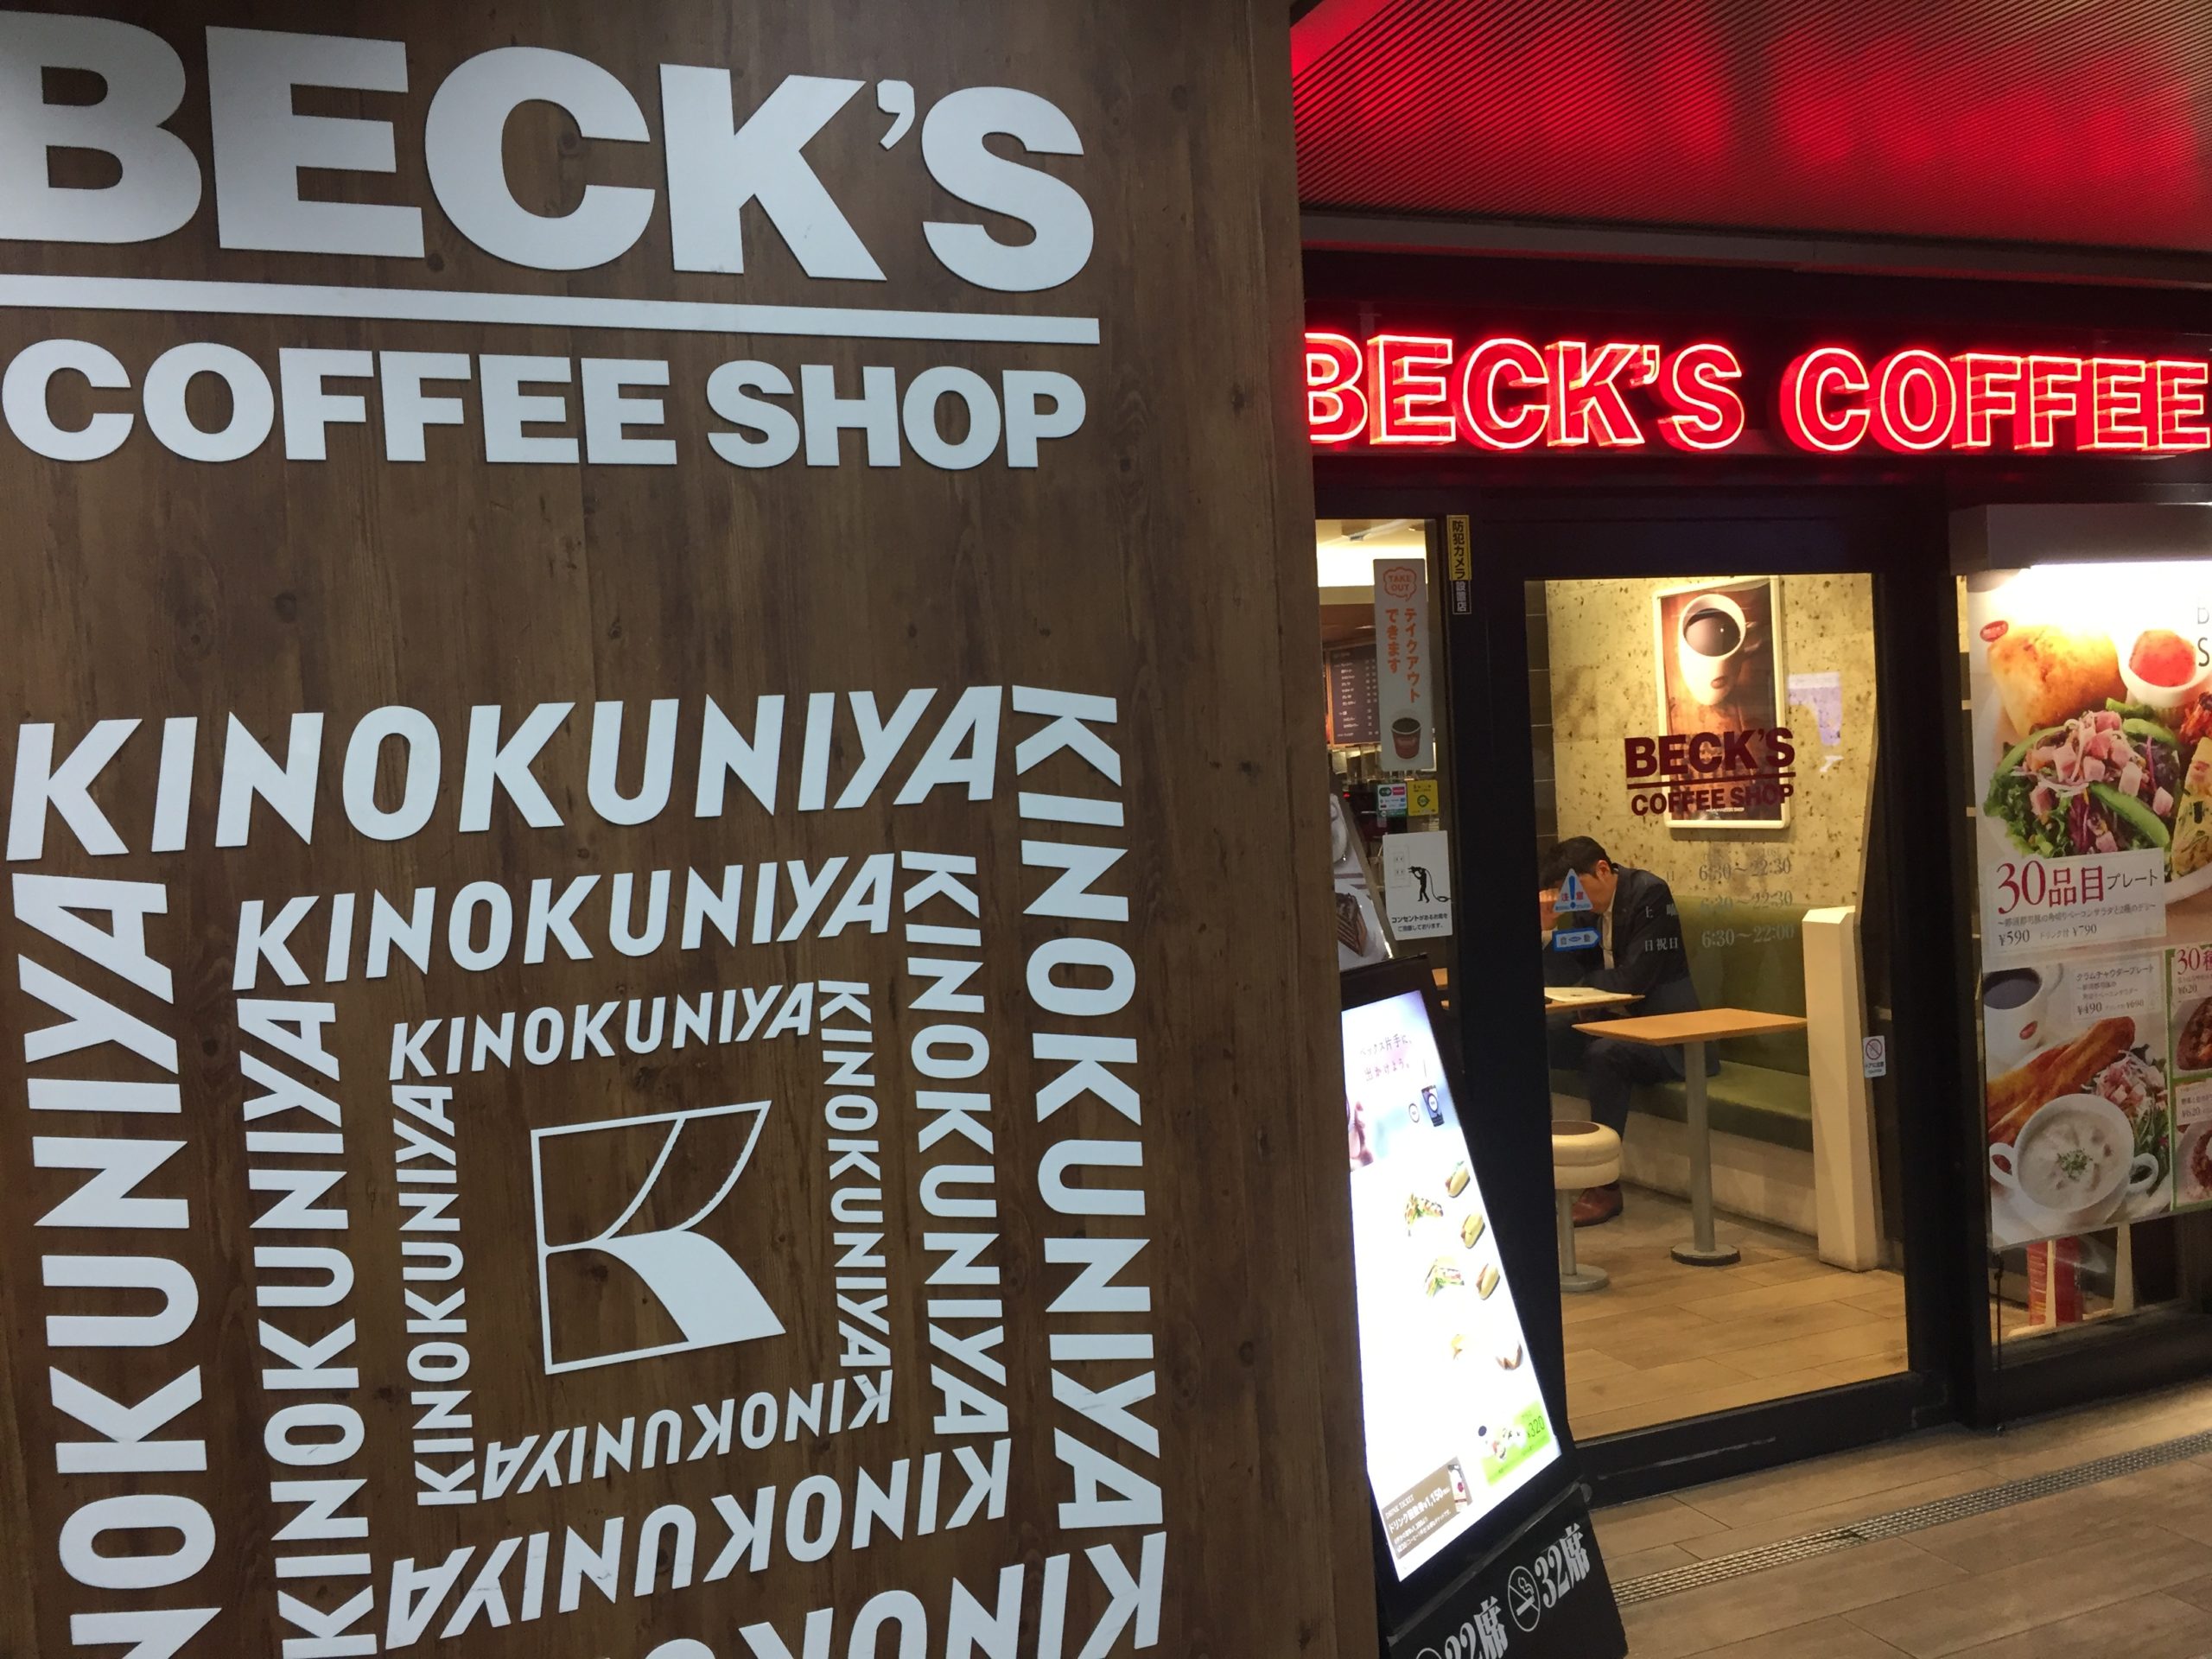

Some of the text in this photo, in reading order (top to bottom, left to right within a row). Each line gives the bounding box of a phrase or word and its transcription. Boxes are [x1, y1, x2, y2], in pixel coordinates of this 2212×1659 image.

[0, 10, 1095, 292] BECK'S
[2, 339, 1086, 471] COFFEE SHOP
[1305, 332, 2211, 452] BECK'S COFFEE
[1452, 520, 1465, 579] 防犯カメラ
[1385, 608, 1401, 674] できます
[1405, 607, 1421, 703] テイクアウト
[6, 685, 1002, 861] KINOKUNIYA
[1624, 727, 1796, 779] BECK'S
[1630, 783, 1795, 817] COFFEE SHOP
[232, 853, 895, 990] KINOKUNIYA
[1999, 929, 2031, 946] ¥590
[389, 982, 815, 1080] KINOKUNIYA
[901, 850, 1009, 1435] KINOKUNIYA
[1012, 685, 1164, 1529] KINOKUNIYA
[818, 980, 892, 1367] KINOKUNIYA
[237, 998, 378, 1659] KINOKUNIYA
[391, 1084, 477, 1505] KINOKUNIYA
[482, 1370, 893, 1500] KINOKUNIYA
[385, 1438, 1011, 1649] KINOKUNIYA
[1535, 1522, 1590, 1608] 32席
